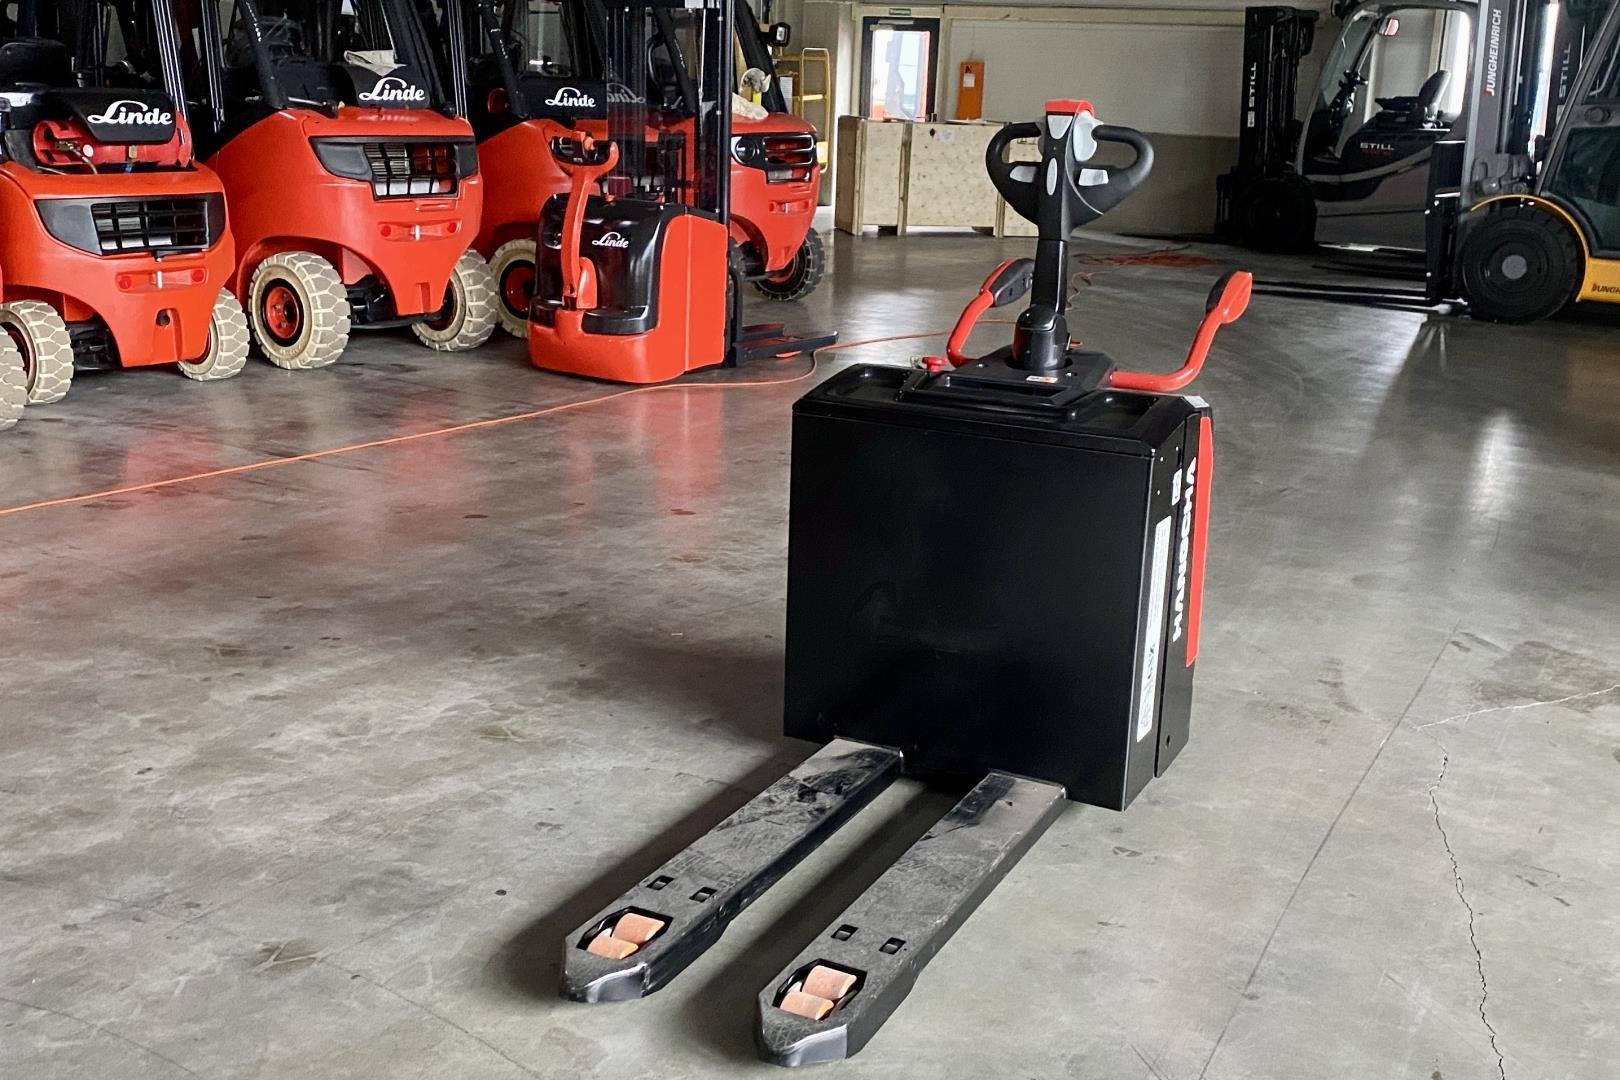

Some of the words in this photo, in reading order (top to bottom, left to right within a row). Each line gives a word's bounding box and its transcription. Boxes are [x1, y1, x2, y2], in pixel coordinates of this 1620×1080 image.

[1484, 9, 1502, 97] JUNGHEINRICH
[1558, 42, 1571, 98] STILL
[359, 76, 425, 101] Linde
[544, 86, 597, 107] Linde
[1248, 62, 1257, 108] STILL
[87, 100, 172, 126] Linde
[591, 231, 629, 249] Linde
